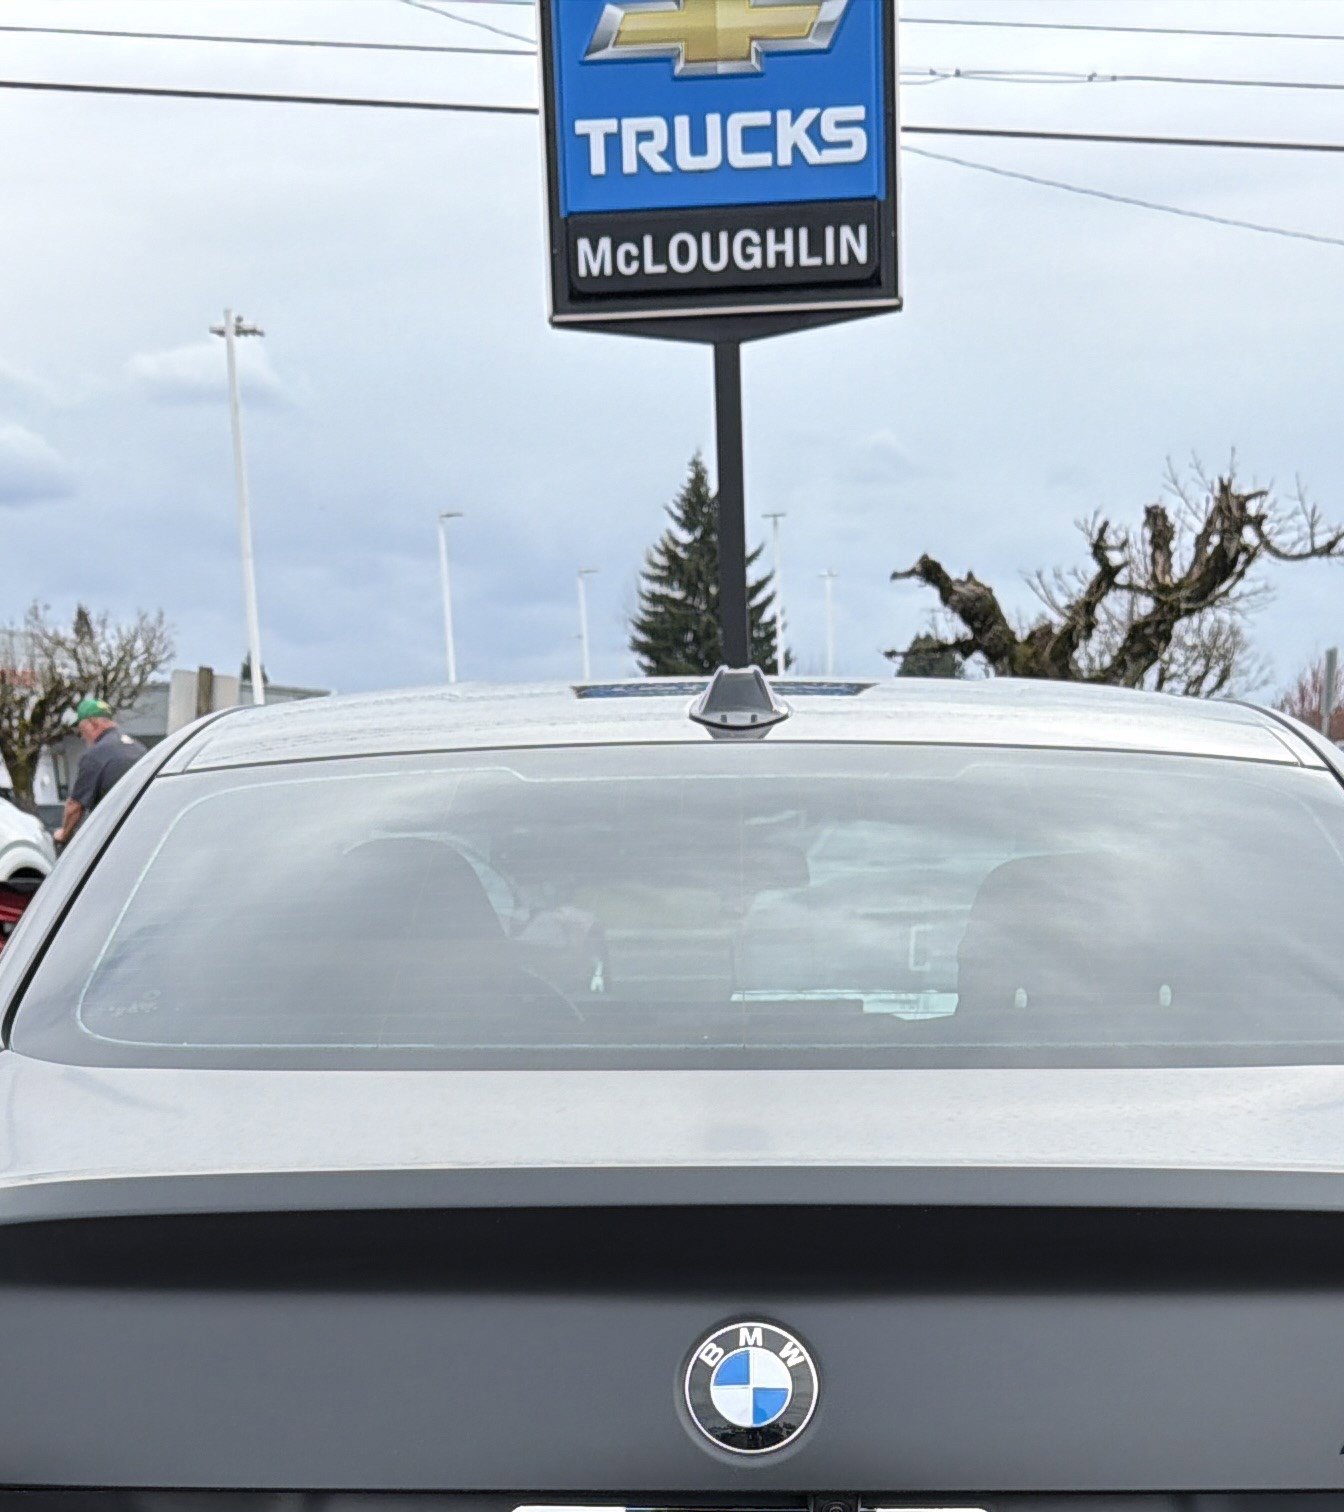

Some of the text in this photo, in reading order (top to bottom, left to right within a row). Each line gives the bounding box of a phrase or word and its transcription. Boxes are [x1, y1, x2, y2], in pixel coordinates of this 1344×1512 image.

[574, 104, 868, 176] TRUCKS
[576, 223, 868, 278] McLOUGHLIN
[699, 1327, 805, 1368] BMW
